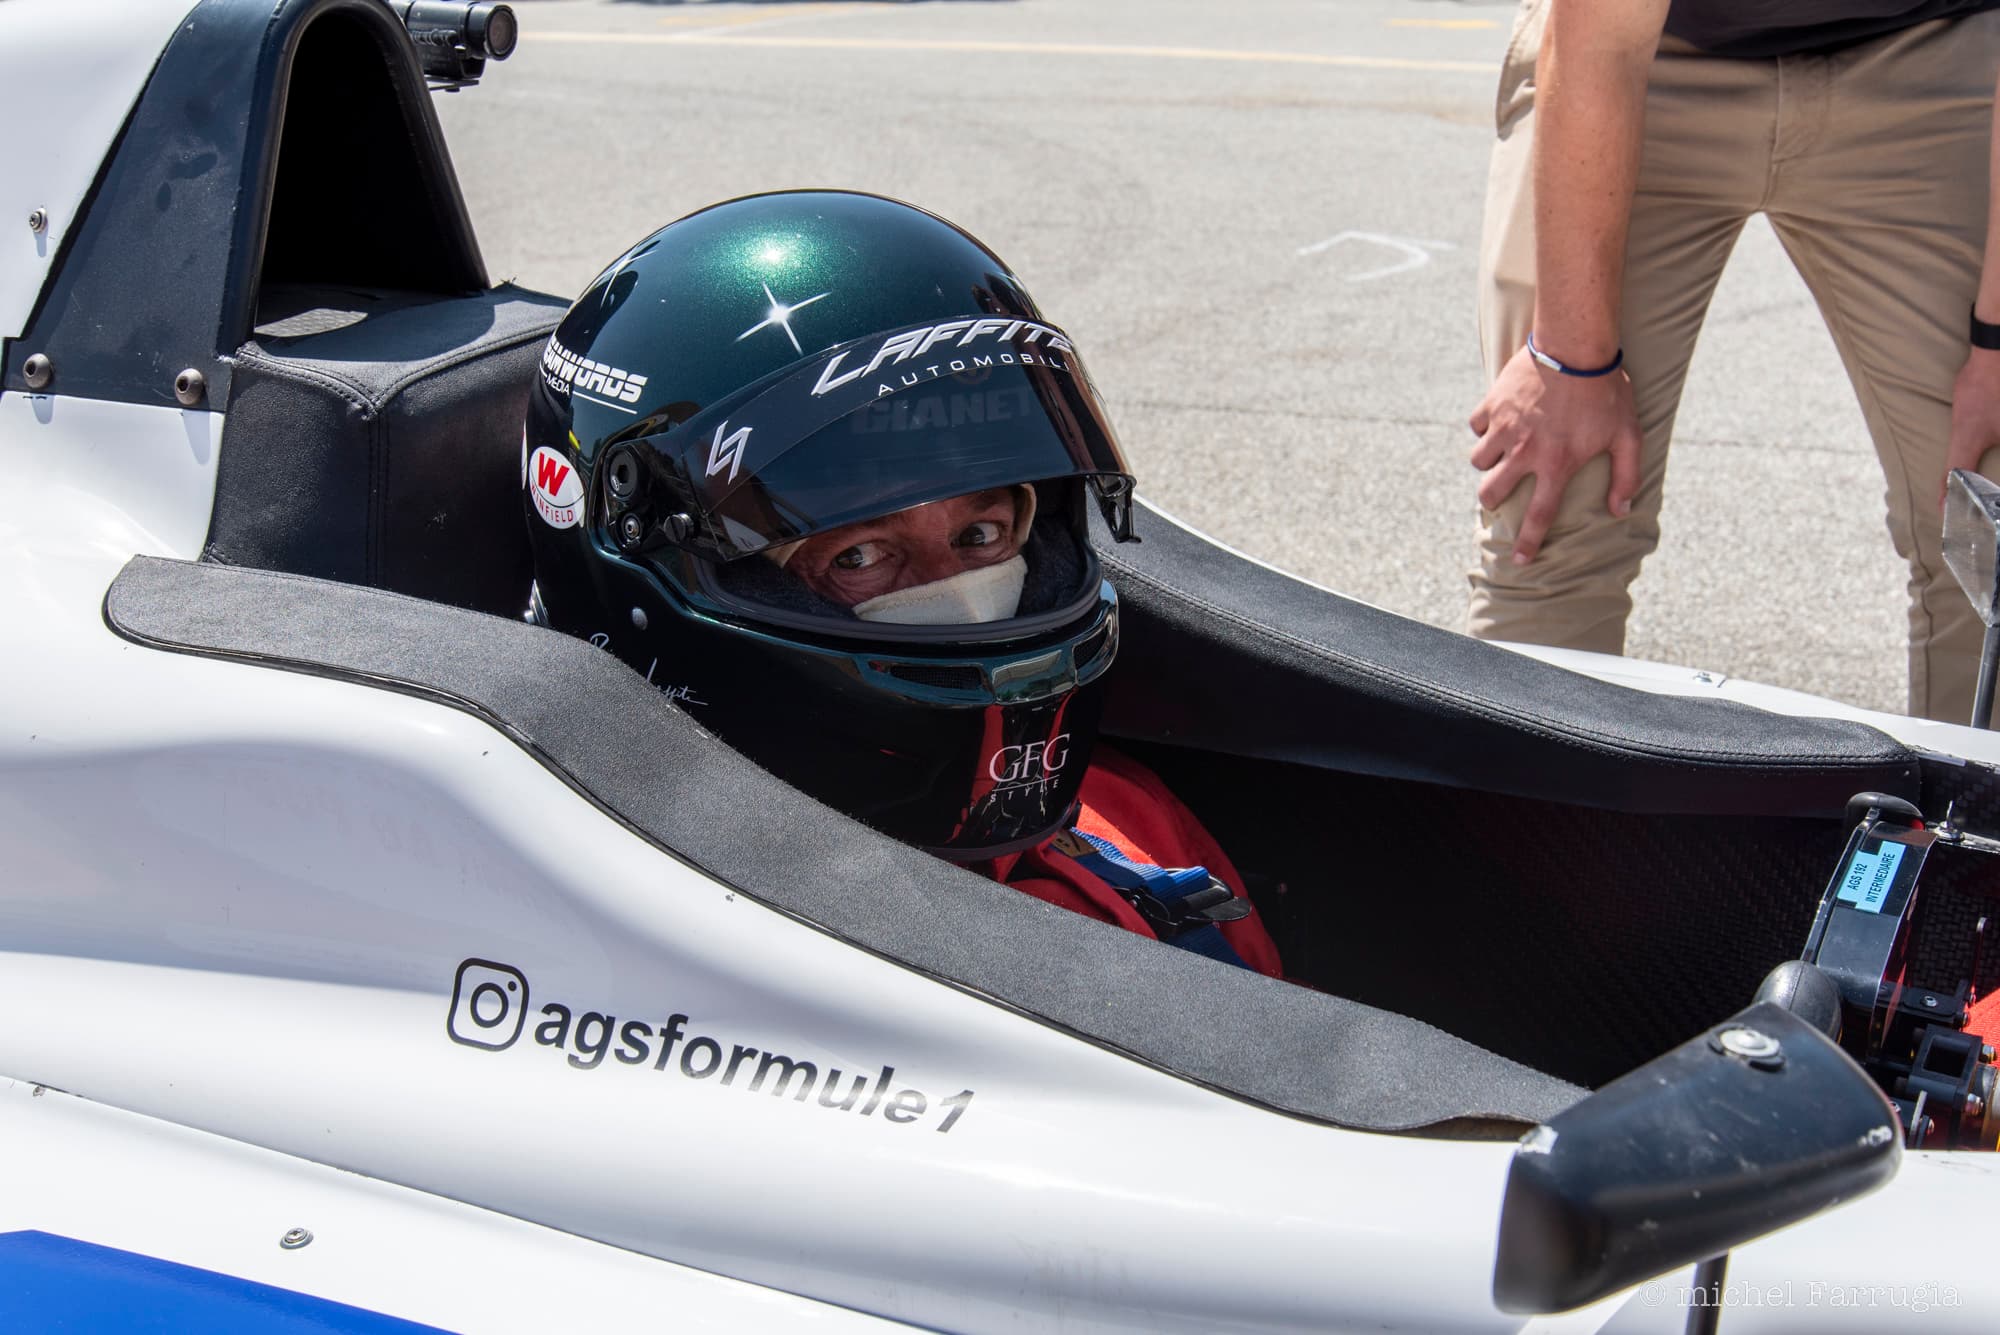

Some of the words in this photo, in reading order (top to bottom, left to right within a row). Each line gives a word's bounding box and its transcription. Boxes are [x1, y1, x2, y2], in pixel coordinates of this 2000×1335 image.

[546, 374, 570, 396] MEDIA
[537, 452, 570, 497] W
[530, 484, 574, 523] WINFIELD
[988, 734, 1070, 782] GFG
[1847, 875, 1864, 891] AGS
[1855, 863, 1868, 876] 192
[1865, 852, 1896, 903] INTERMEDIAIRE
[534, 1002, 975, 1134] agsformule1
